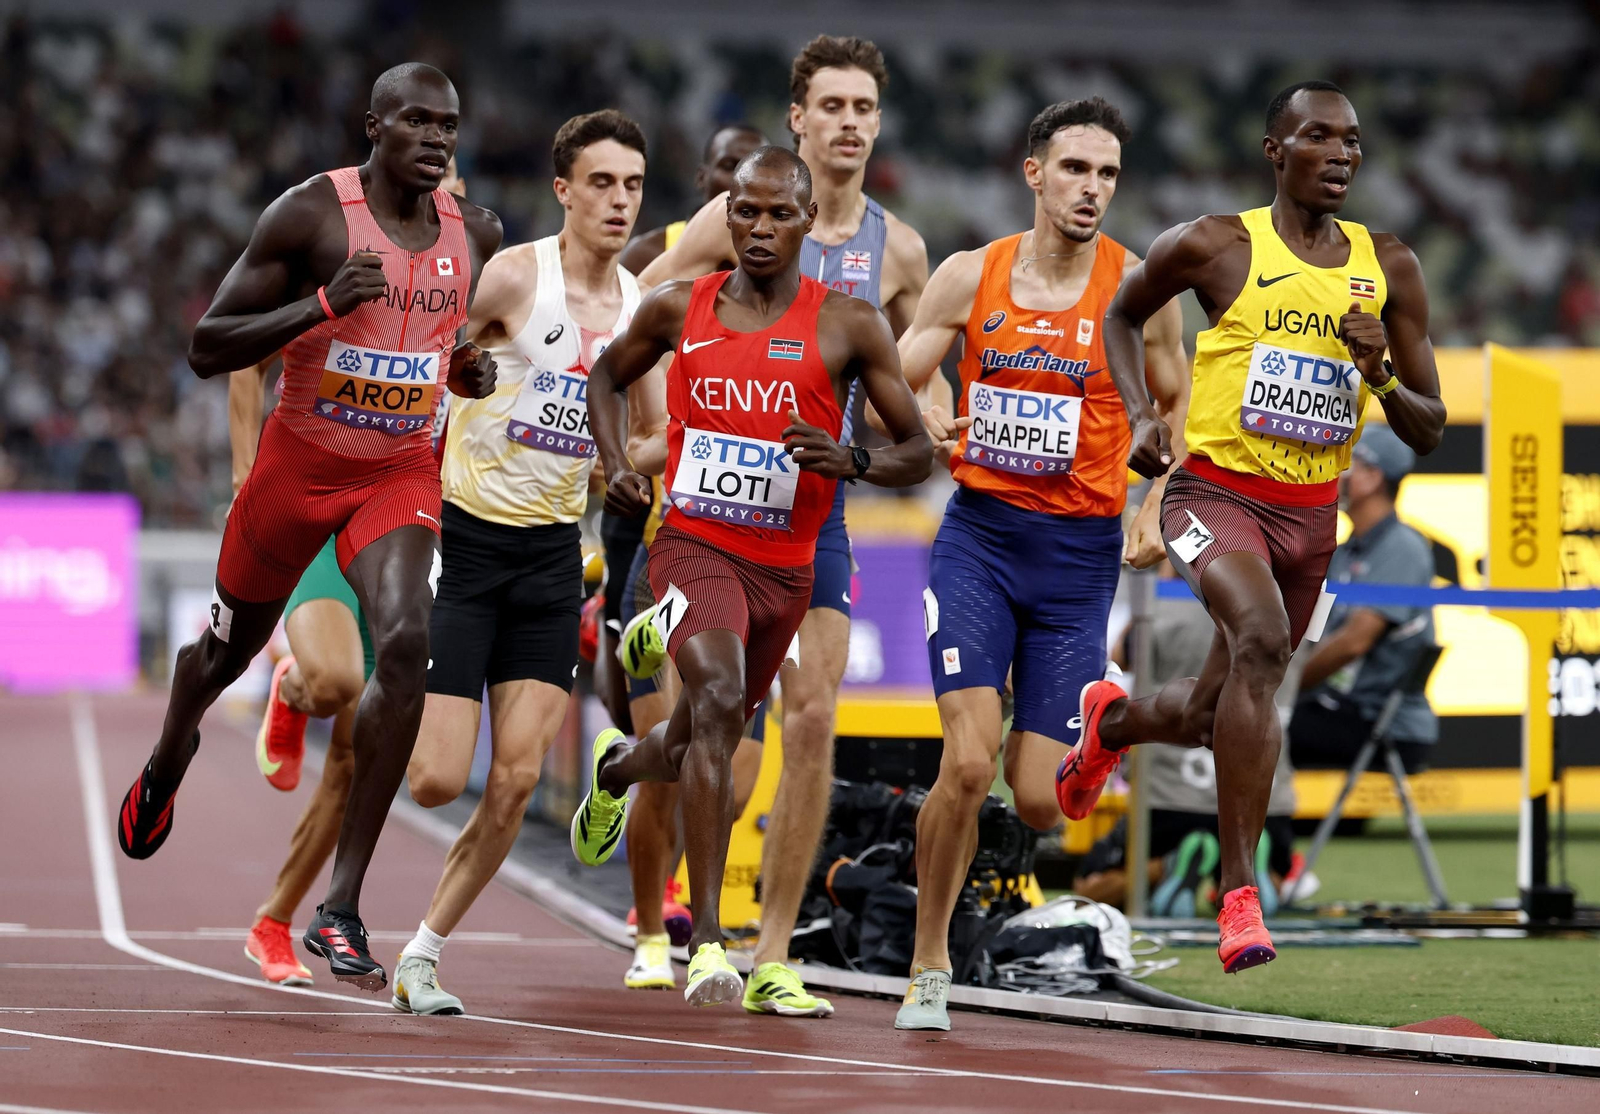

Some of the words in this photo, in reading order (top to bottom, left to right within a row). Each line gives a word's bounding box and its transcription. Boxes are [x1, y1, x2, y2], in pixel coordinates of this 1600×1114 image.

[382, 282, 458, 315] ANADA
[1016, 325, 1065, 337] Staatsloterij
[1265, 309, 1342, 340] UGAN
[363, 352, 433, 380] TDK
[1287, 354, 1356, 391] TDK
[335, 379, 423, 411] AROP
[689, 377, 799, 415] KENYA
[993, 390, 1070, 423] TDK
[1250, 380, 1353, 424] DRADRIGA
[973, 416, 1071, 455] CHAPPLE
[713, 437, 790, 473] TDK
[698, 467, 772, 503] LOTI
[1510, 434, 1539, 568] SEIKO
